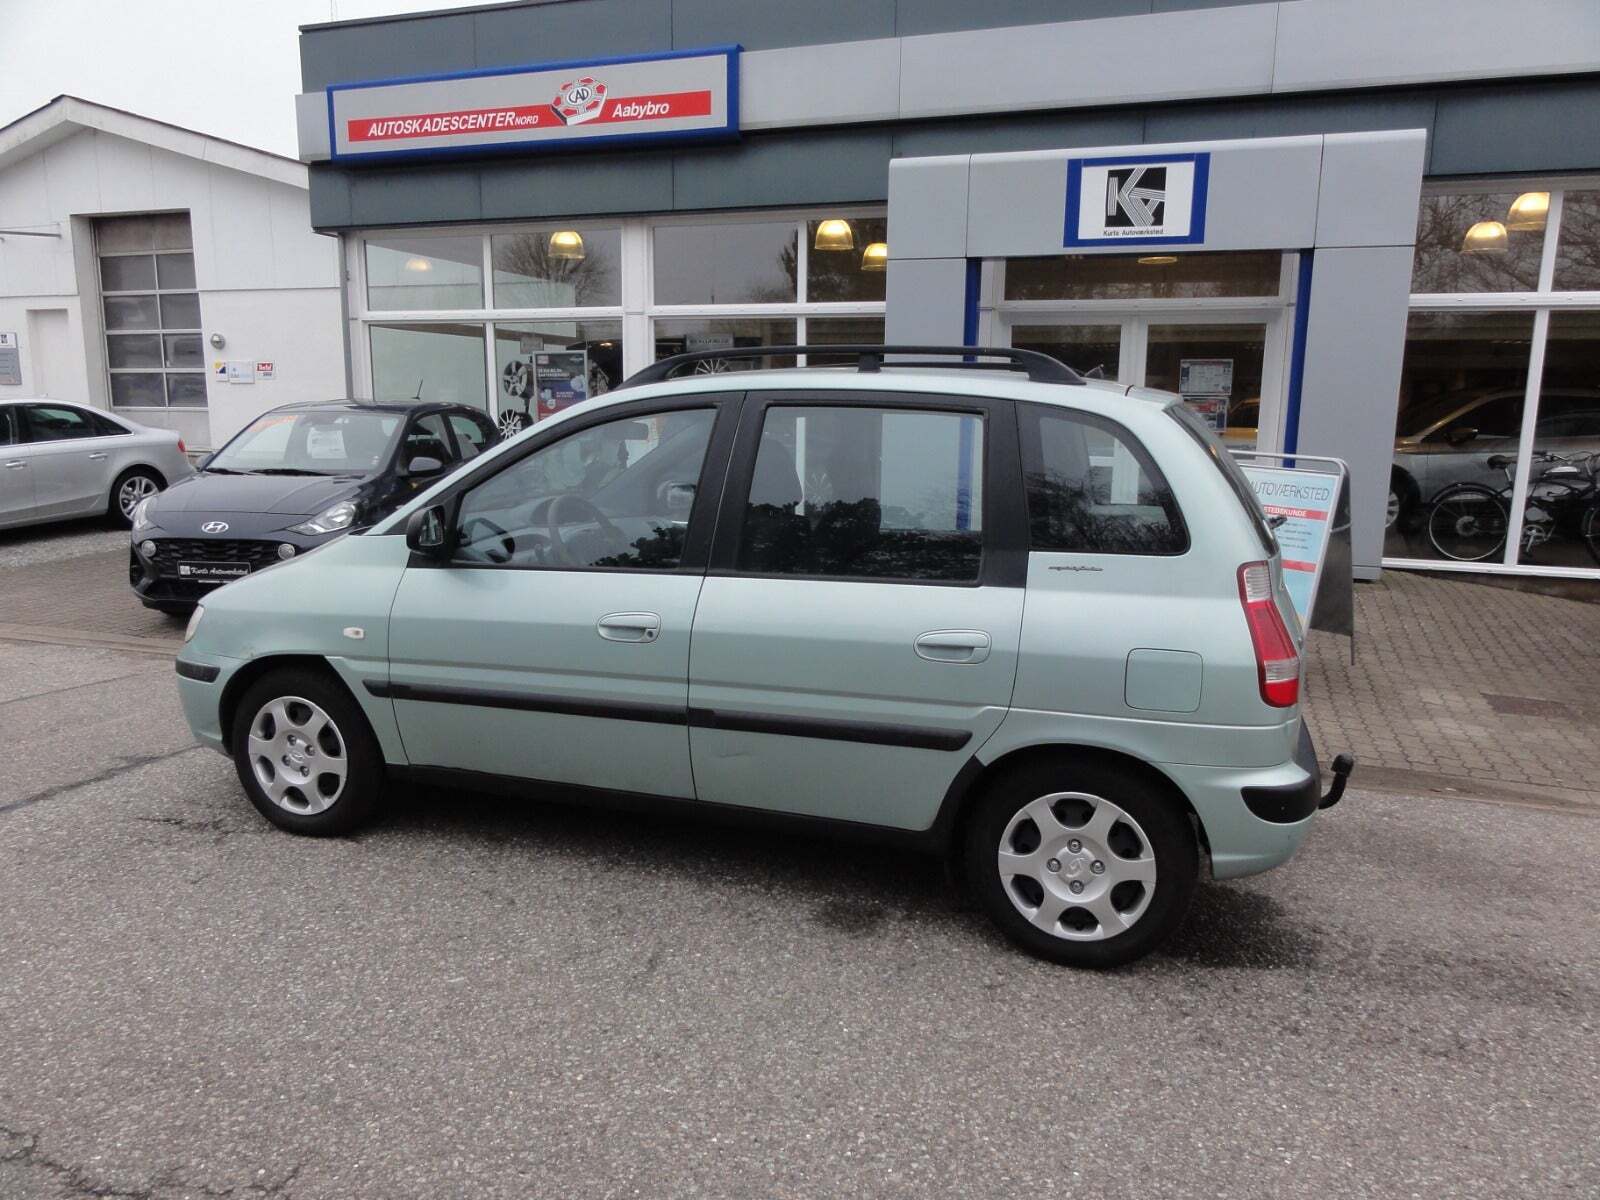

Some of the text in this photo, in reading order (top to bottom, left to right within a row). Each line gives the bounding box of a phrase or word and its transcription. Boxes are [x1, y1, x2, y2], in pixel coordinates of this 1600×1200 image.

[568, 88, 590, 104] CAD
[612, 101, 670, 118] Aabybro
[368, 112, 539, 136] AUTOSKADESCENTER NORD
